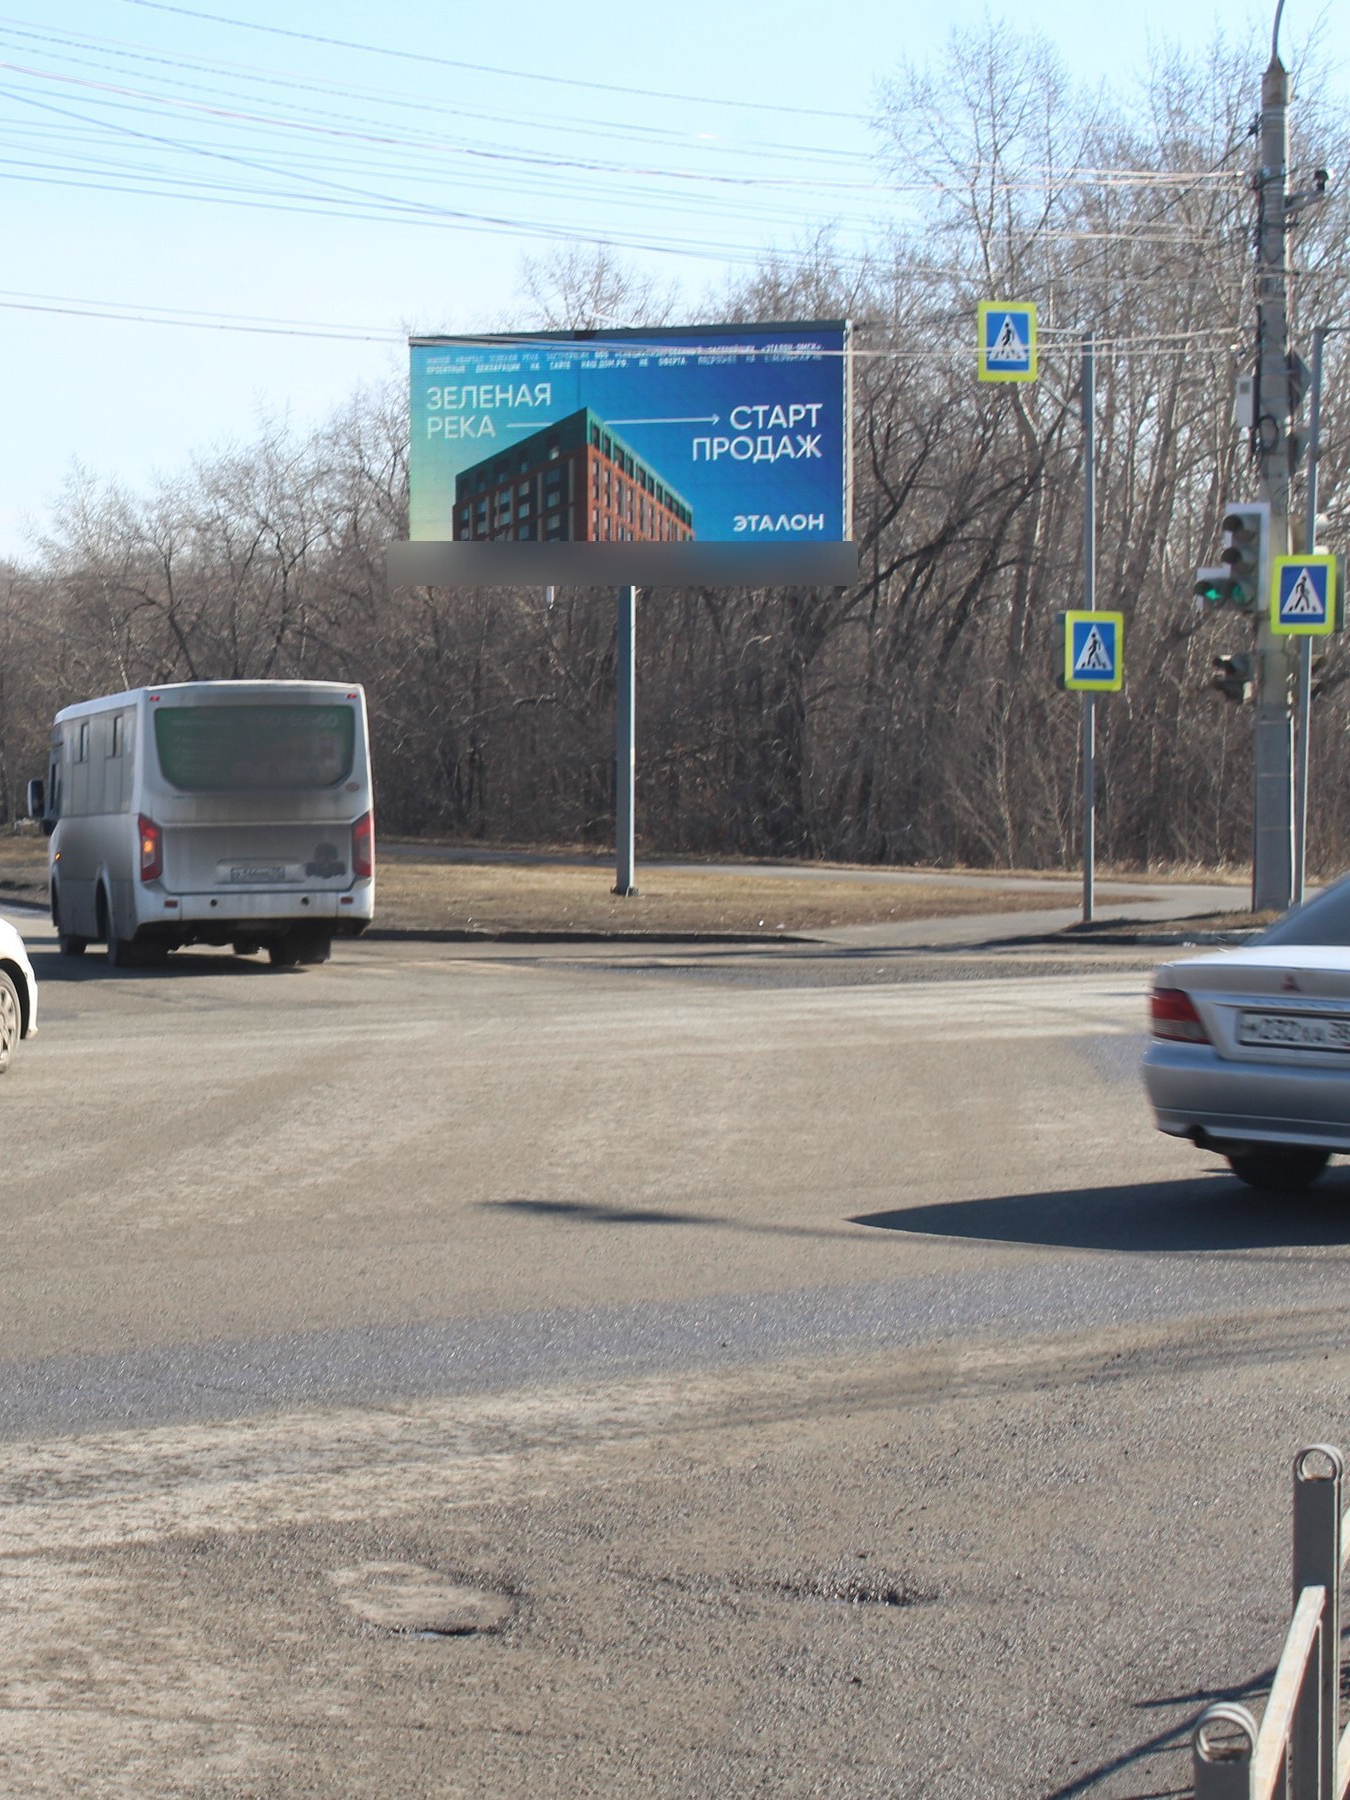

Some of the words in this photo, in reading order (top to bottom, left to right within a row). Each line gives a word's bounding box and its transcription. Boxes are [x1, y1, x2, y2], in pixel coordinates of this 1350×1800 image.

[426, 382, 551, 410] ЗЕЛЕНАЯ
[427, 415, 496, 439] РЕКА
[730, 403, 823, 430] СТАРТ
[692, 434, 823, 463] ПРОДАЖ
[733, 513, 824, 532] ЭТАЛОН
